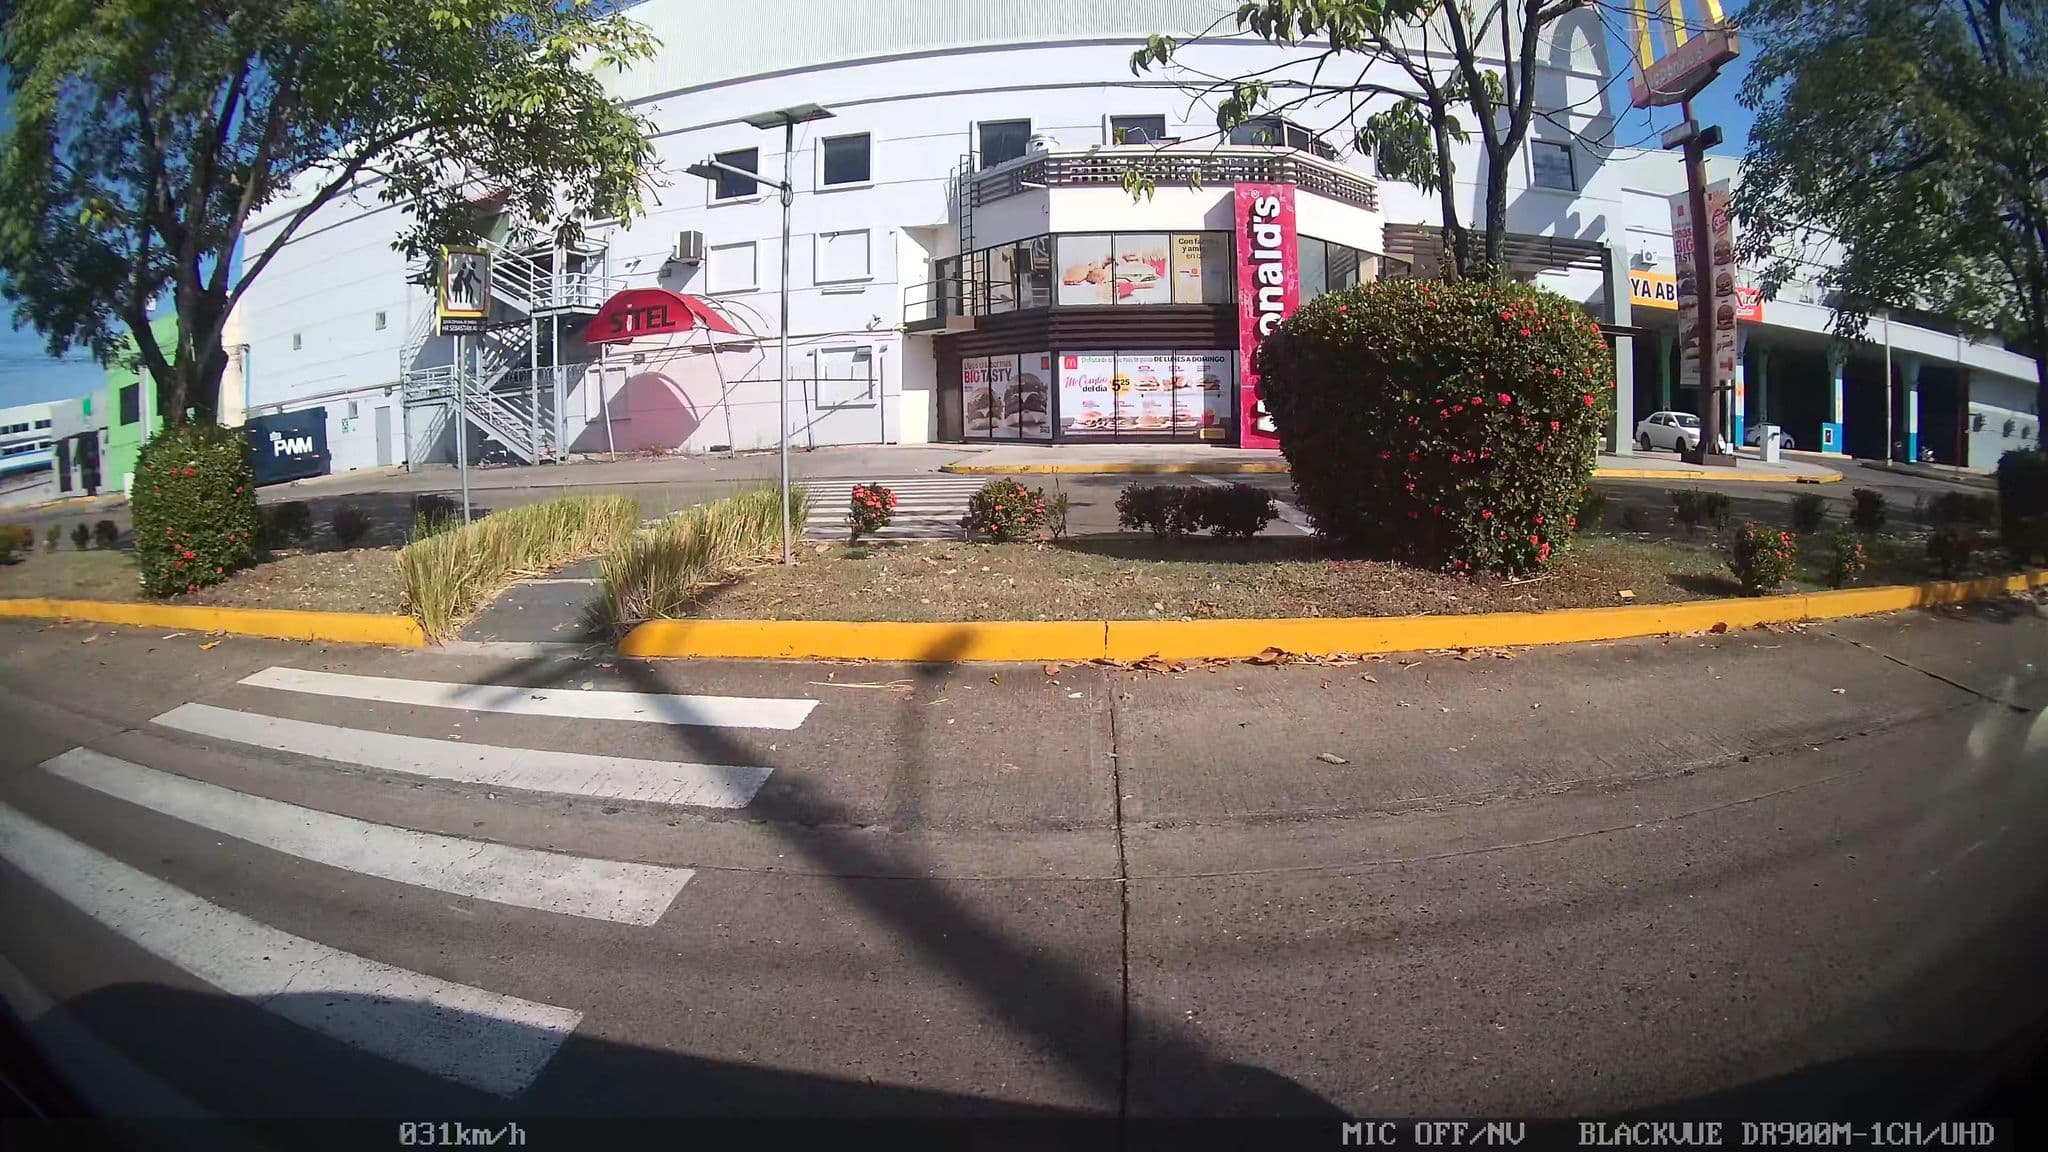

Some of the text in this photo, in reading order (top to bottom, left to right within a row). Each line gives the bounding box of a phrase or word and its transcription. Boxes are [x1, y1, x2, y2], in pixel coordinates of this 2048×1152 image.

[1675, 238, 1694, 254] BIG
[1675, 252, 1693, 263] TAST
[1631, 278, 1675, 301] YA AB
[1253, 196, 1285, 433] onald's
[964, 368, 1012, 383] BIG TASTY
[274, 436, 313, 457] PWM
